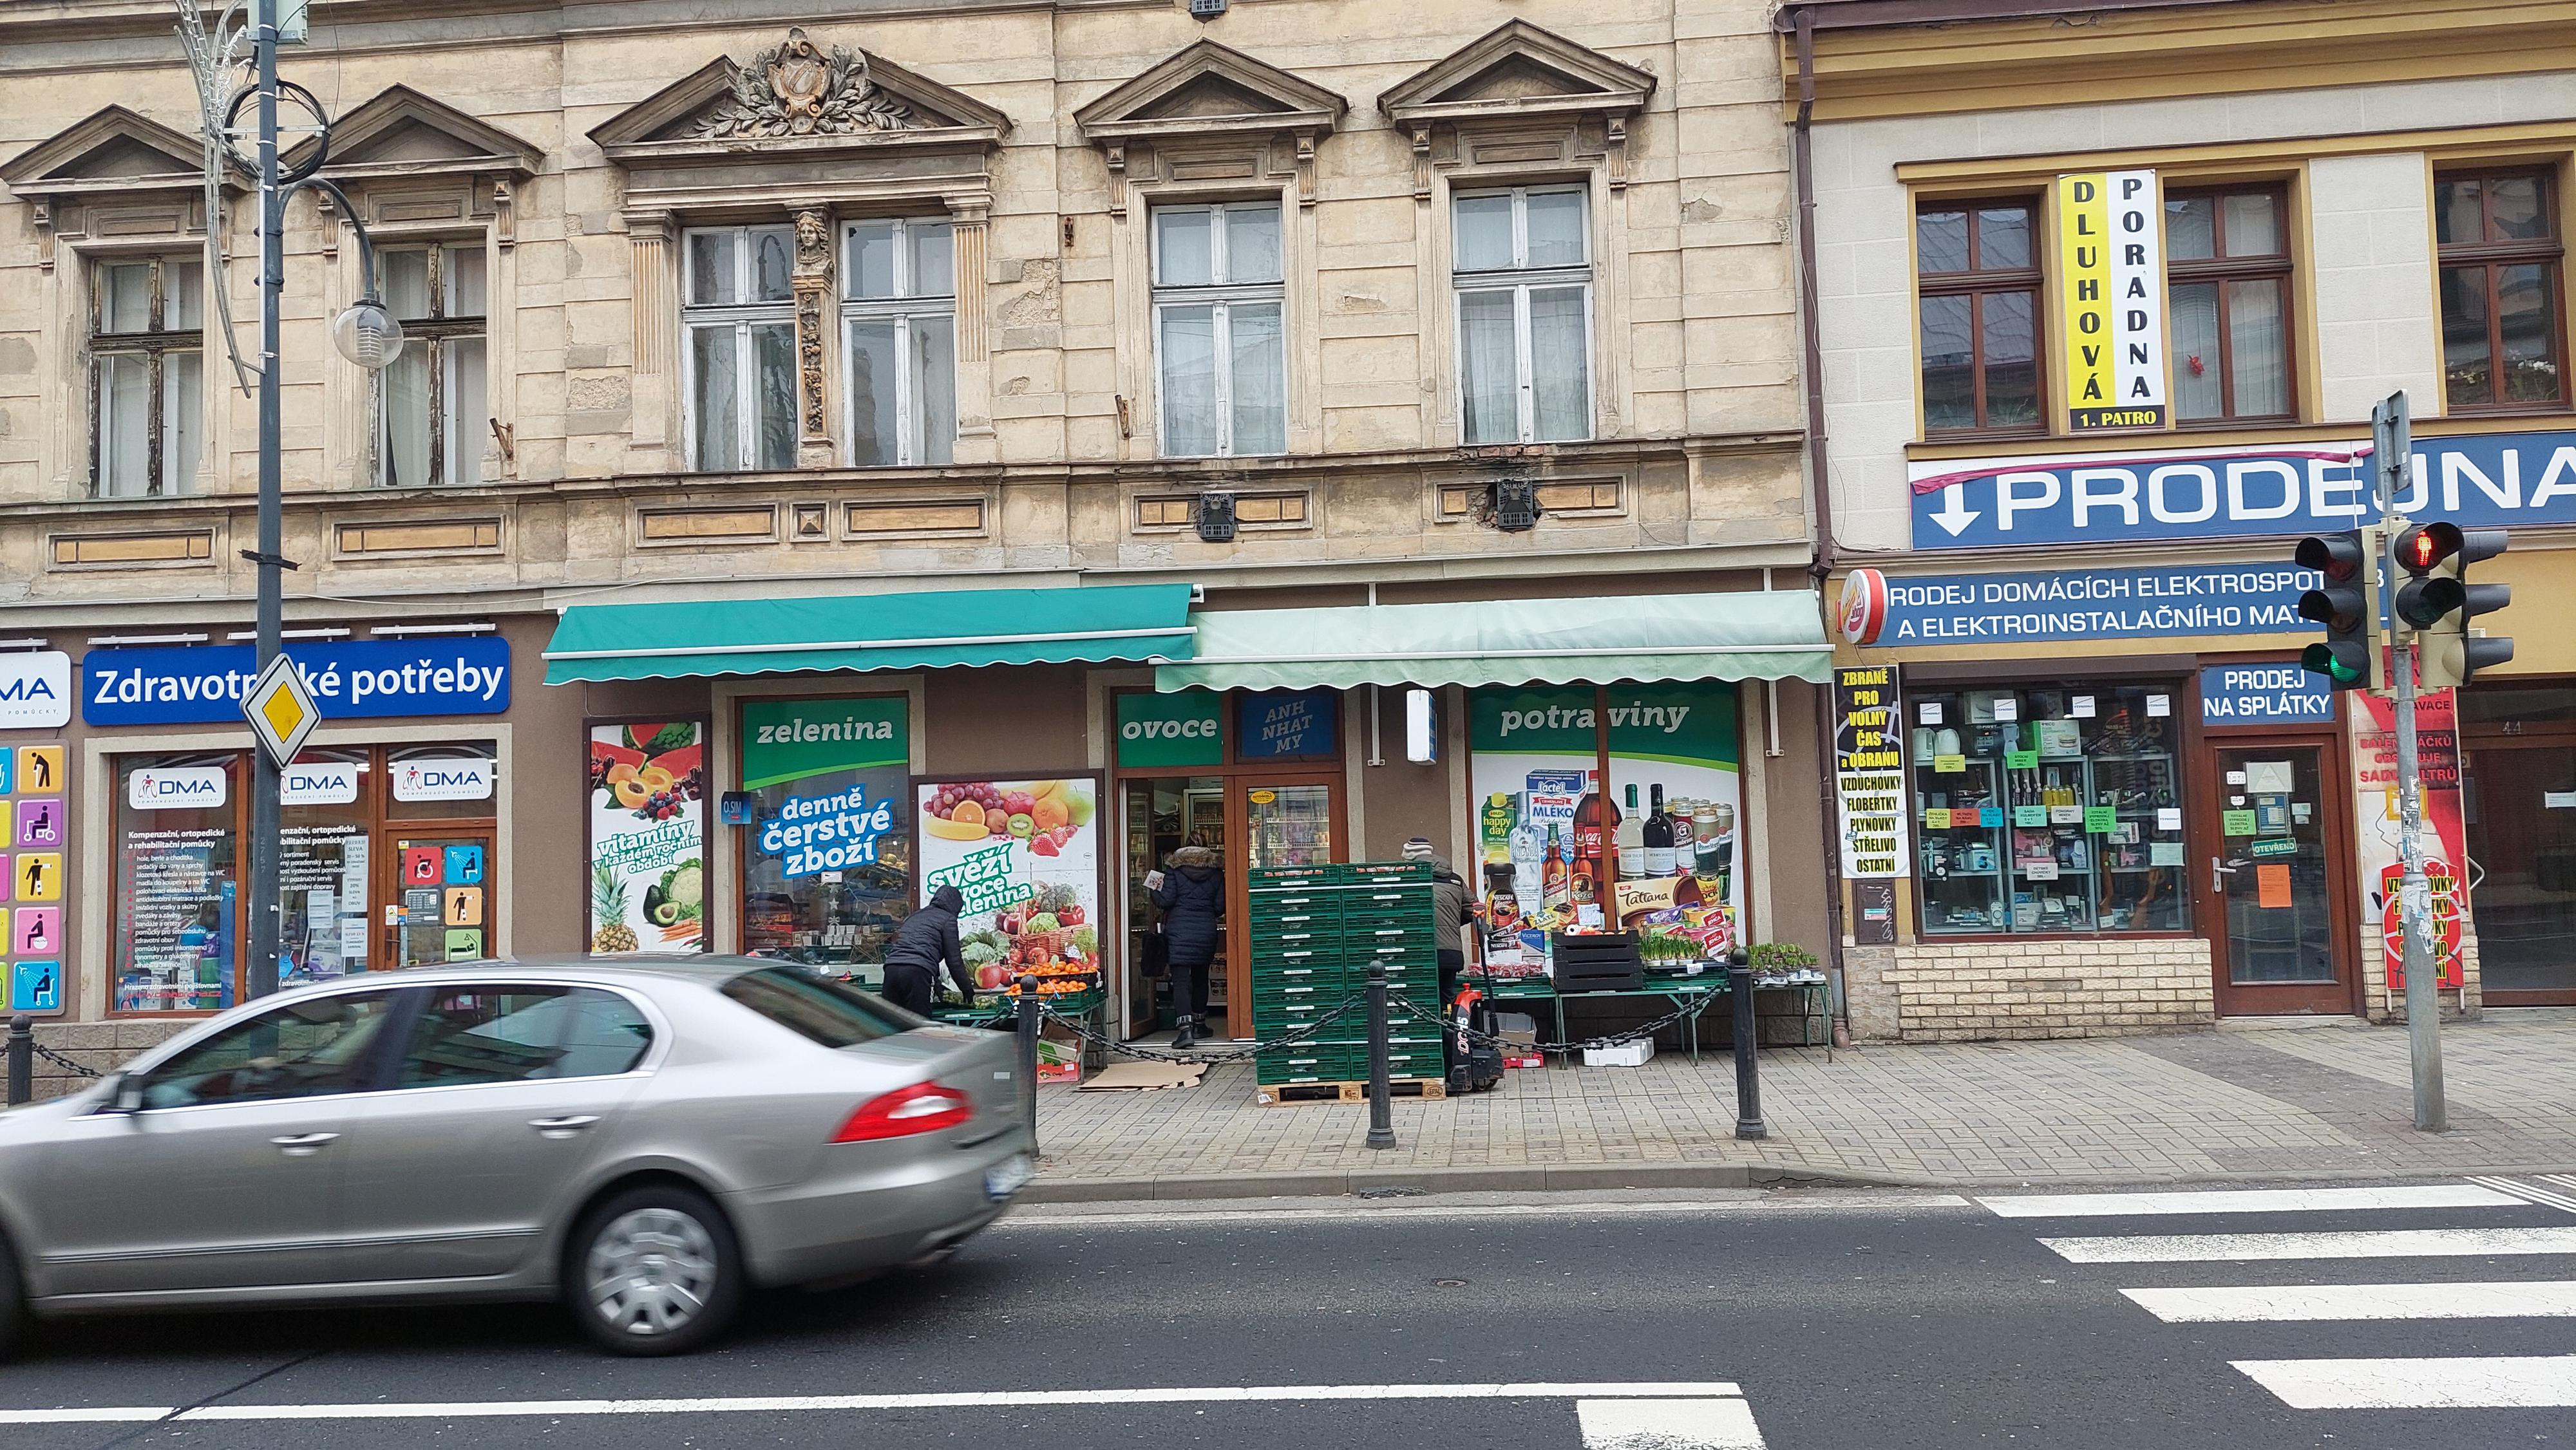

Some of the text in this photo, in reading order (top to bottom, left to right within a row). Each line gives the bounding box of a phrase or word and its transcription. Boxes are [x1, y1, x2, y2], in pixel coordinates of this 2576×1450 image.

[2074, 182, 2102, 400] DLUHOVÁ
[2123, 178, 2151, 397] PORADNA
[2080, 411, 2157, 427] 1. PATRO
[1996, 446, 2576, 531] PRODEJNA
[1889, 585, 1975, 607] RODEJ
[1984, 575, 2130, 603] DOMÁCÍCH
[2138, 569, 2325, 598] ELEKTROSPOT
[1897, 619, 1917, 639] A
[1922, 603, 2241, 637] ELEKTROINSTALAČNÍHO
[94, 657, 504, 704] Zdravotké potřeby
[1842, 668, 1888, 686] ZBRANĚ
[2224, 670, 2306, 690] PRODEJ
[1854, 690, 1879, 706] PRO
[2204, 692, 2331, 717] NA SPLÁTKY
[2385, 699, 2451, 711] VAVAČE
[1265, 700, 1306, 723] ANH
[1848, 708, 1887, 726] VOLNÝ
[757, 717, 893, 743] zelenina
[1122, 719, 1217, 739] ovoce
[1262, 715, 1313, 740] NHAT
[1275, 734, 1303, 753] MY
[1857, 730, 1882, 746] ČAS
[2418, 734, 2452, 747] ÁČKŮ
[1841, 751, 1899, 767] a OBRANU
[2374, 752, 2441, 764] OBSUJE
[424, 772, 482, 786] DMA
[2420, 766, 2457, 781] LTRŮ
[160, 780, 216, 795] DMA
[290, 775, 346, 790] DMA
[1841, 777, 1901, 791] VZDUCHOVKY
[782, 787, 862, 820] denně
[1533, 804, 1574, 817] MLÉKO
[1846, 796, 1897, 811] FLOBERTKY
[280, 825, 356, 834] enzační, ortopedické
[763, 802, 889, 851] čerstvé
[1484, 817, 1511, 827] happy
[1850, 817, 1897, 831] PLYNOVKY
[129, 829, 225, 839] Kompenzační, ortopedické
[598, 821, 694, 856] vitamíny
[1489, 826, 1507, 836] day
[135, 840, 180, 849] rehabilitační
[181, 840, 215, 849] pomůcky
[280, 836, 310, 845] bilitační
[312, 836, 346, 845] pomůcky
[1853, 836, 1897, 852] STŘELIVO
[2254, 842, 2295, 854] OTEVŘENO
[605, 847, 654, 865] každém
[629, 853, 674, 872] období
[786, 834, 876, 875] zboží
[929, 845, 1012, 894] svěží
[1857, 856, 1895, 872] OSTATNÍ
[960, 878, 1005, 900] voce
[2387, 876, 2454, 893] VZOVKY
[958, 886, 1030, 916] elenina
[1618, 891, 1669, 907] Tatiana
